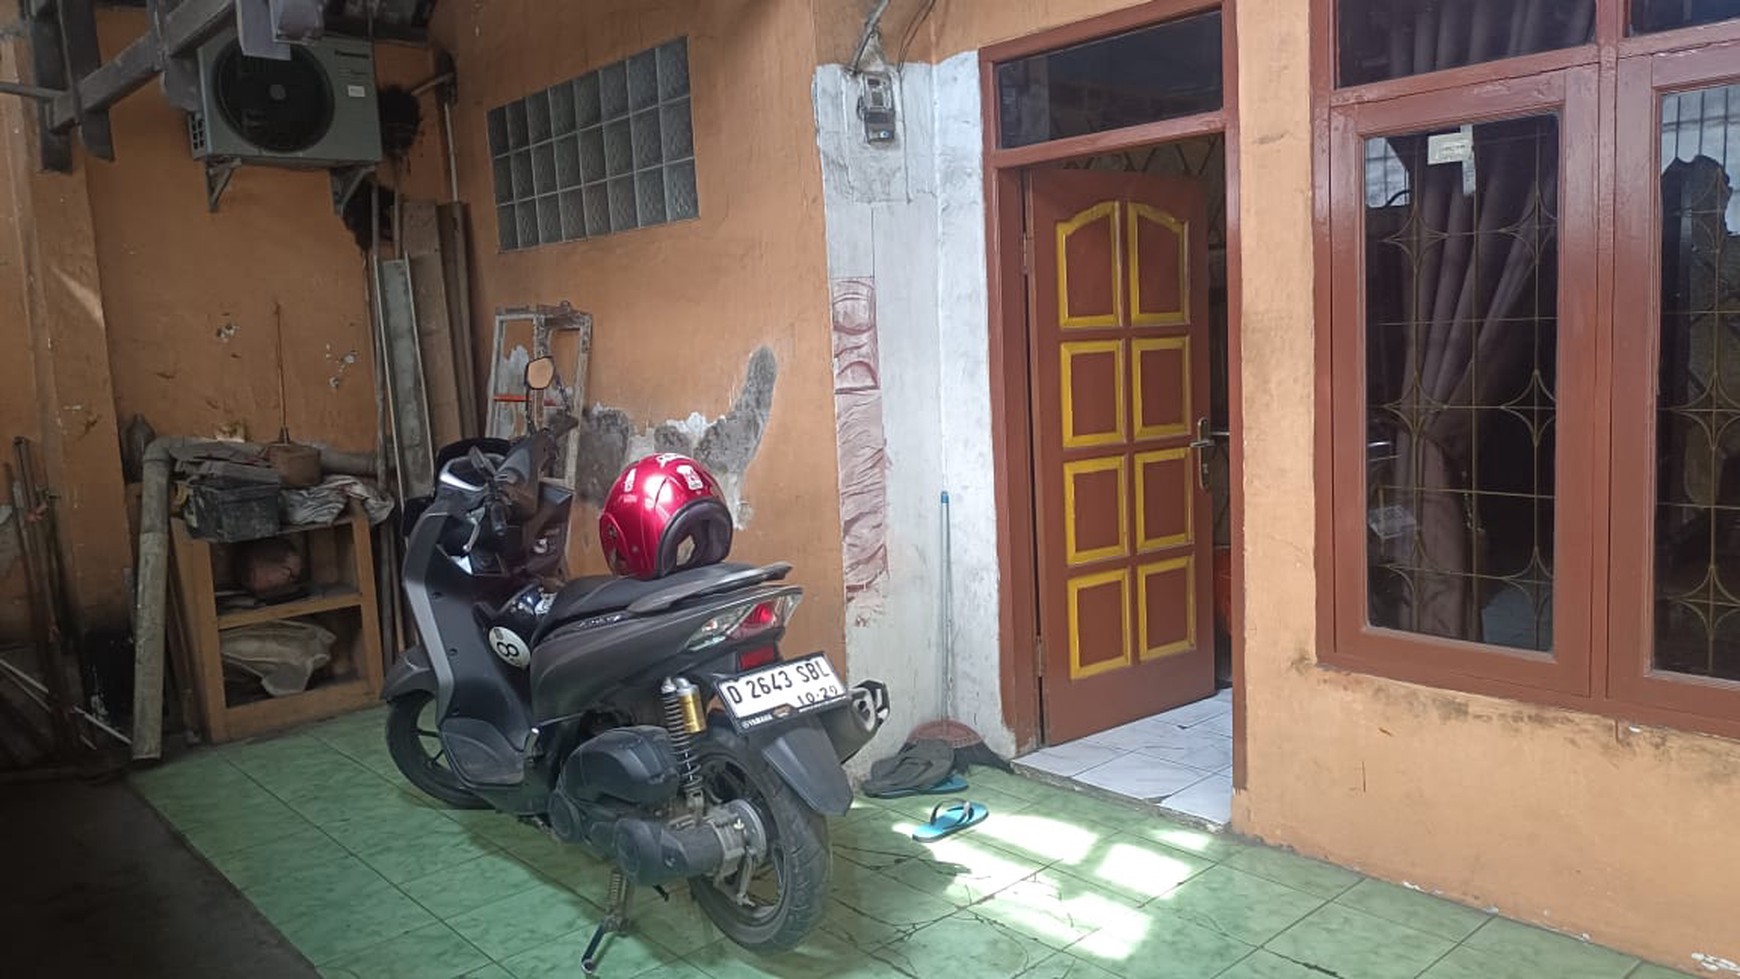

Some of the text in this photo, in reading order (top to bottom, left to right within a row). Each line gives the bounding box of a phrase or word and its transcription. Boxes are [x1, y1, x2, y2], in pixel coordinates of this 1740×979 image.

[496, 641, 519, 657] 8
[726, 659, 831, 704] D 2643 SBL
